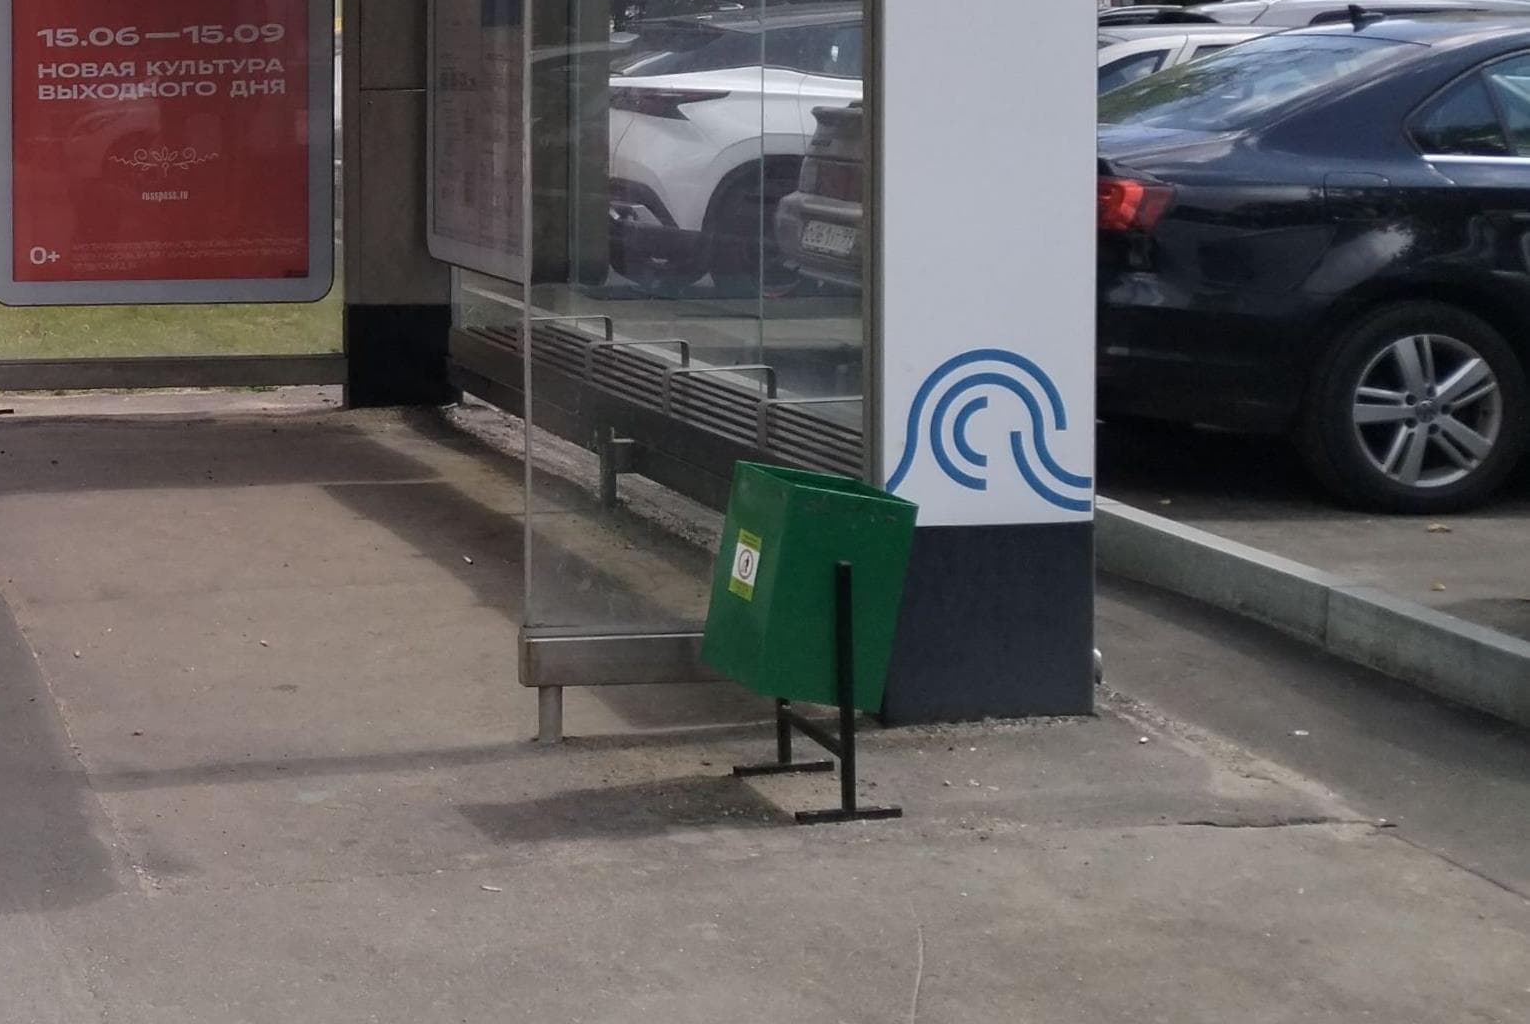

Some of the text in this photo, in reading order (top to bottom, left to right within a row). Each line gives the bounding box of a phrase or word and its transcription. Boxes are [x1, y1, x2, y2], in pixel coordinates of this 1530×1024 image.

[37, 58, 285, 79] НОВАЯ КУЛЬТУРА
[37, 79, 286, 101] ВЫХОДНОГО ДНЯ
[29, 246, 61, 265] 0+
